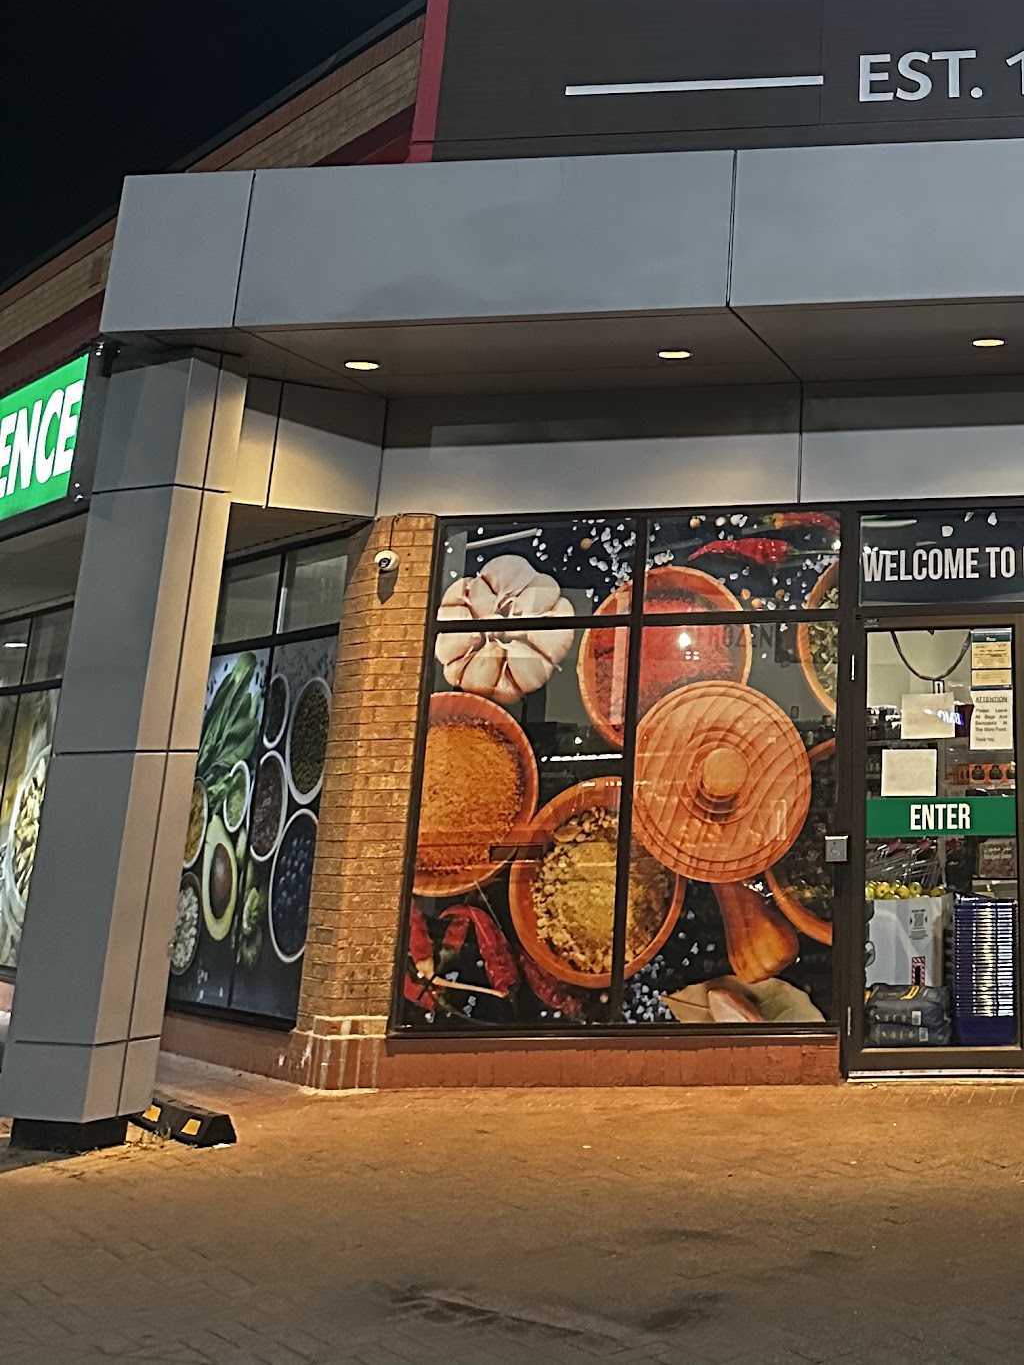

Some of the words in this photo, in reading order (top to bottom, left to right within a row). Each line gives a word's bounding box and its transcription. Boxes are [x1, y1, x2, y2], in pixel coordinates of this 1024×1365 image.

[859, 49, 983, 102] EST.
[862, 547, 979, 582] WELCOME
[985, 546, 1015, 578] TO
[909, 803, 971, 831] ENTER
